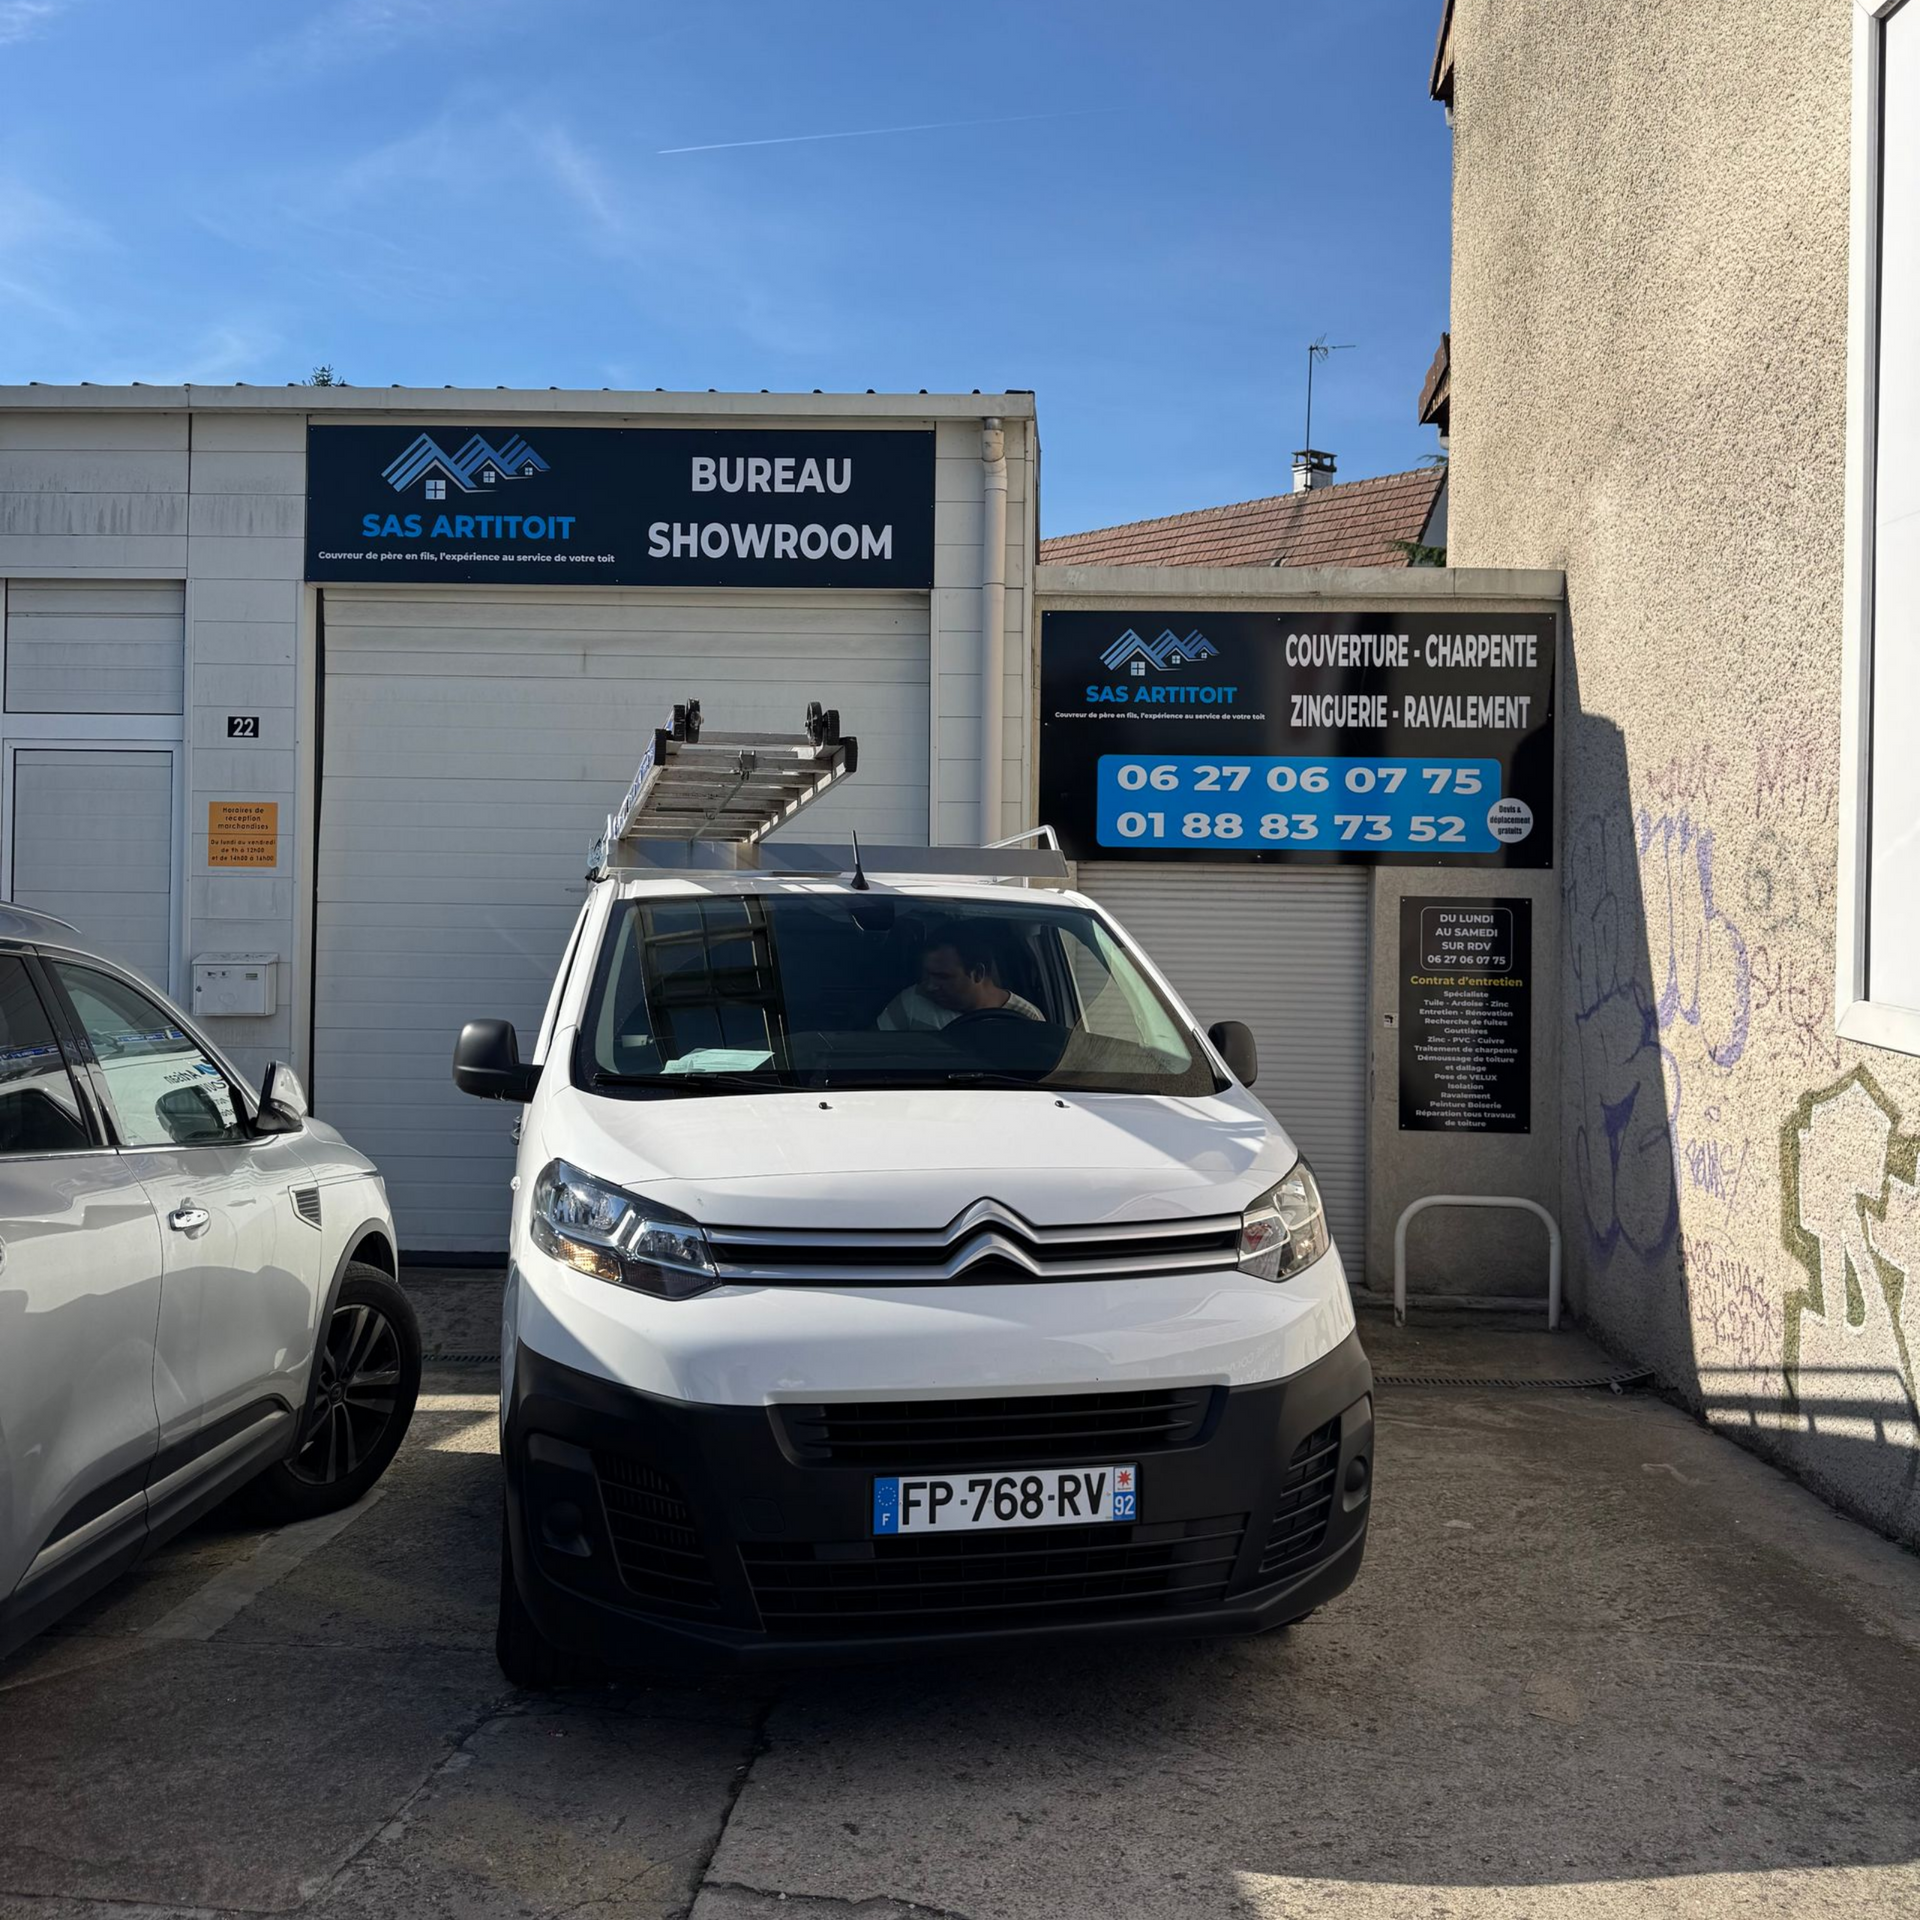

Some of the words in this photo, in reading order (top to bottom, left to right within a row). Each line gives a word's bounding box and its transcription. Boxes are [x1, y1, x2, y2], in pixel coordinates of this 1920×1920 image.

[692, 457, 851, 493] BUREAU
[363, 514, 422, 537] SAS
[431, 515, 575, 539] ARTITOIT
[648, 522, 892, 559] SHOWROOM
[381, 552, 403, 561] père
[420, 552, 437, 561] fils,
[517, 553, 552, 561] service
[597, 554, 614, 562] toit
[1286, 634, 1408, 667] COUVERTURE
[1426, 634, 1537, 667] CHARPENTE
[1087, 686, 1128, 702] SAS
[1134, 686, 1237, 703] ARTITOIT
[1291, 695, 1387, 727] ZINGUERIE
[1405, 696, 1530, 728] RAVALEMENT
[233, 718, 254, 736] 22
[1118, 765, 1178, 790] 06
[1193, 766, 1250, 791] 27
[1267, 766, 1329, 792] 06
[1345, 767, 1407, 793] 07
[1423, 768, 1481, 794] 75
[1117, 812, 1164, 837] 01
[1182, 813, 1243, 838] 88
[1260, 814, 1318, 839] 83
[1334, 815, 1392, 840] 73
[1408, 816, 1465, 841] 52
[1490, 816, 1530, 824] déplacement
[1440, 914, 1456, 923] DU
[1460, 915, 1494, 923] LUNDI
[1435, 928, 1451, 936] AU
[1455, 928, 1497, 937] SAMEDI
[1442, 942, 1464, 950] SUR
[1468, 942, 1491, 950] RDV
[1428, 955, 1441, 963] 06
[1444, 955, 1456, 963] 27
[1460, 956, 1473, 964] 06
[1476, 956, 1489, 964] 07
[1493, 957, 1506, 965] 75
[1411, 976, 1454, 984] Contrat
[902, 1473, 1106, 1525] FP-768-RV
[1114, 1496, 1134, 1515] 92
[882, 1514, 890, 1526] F
